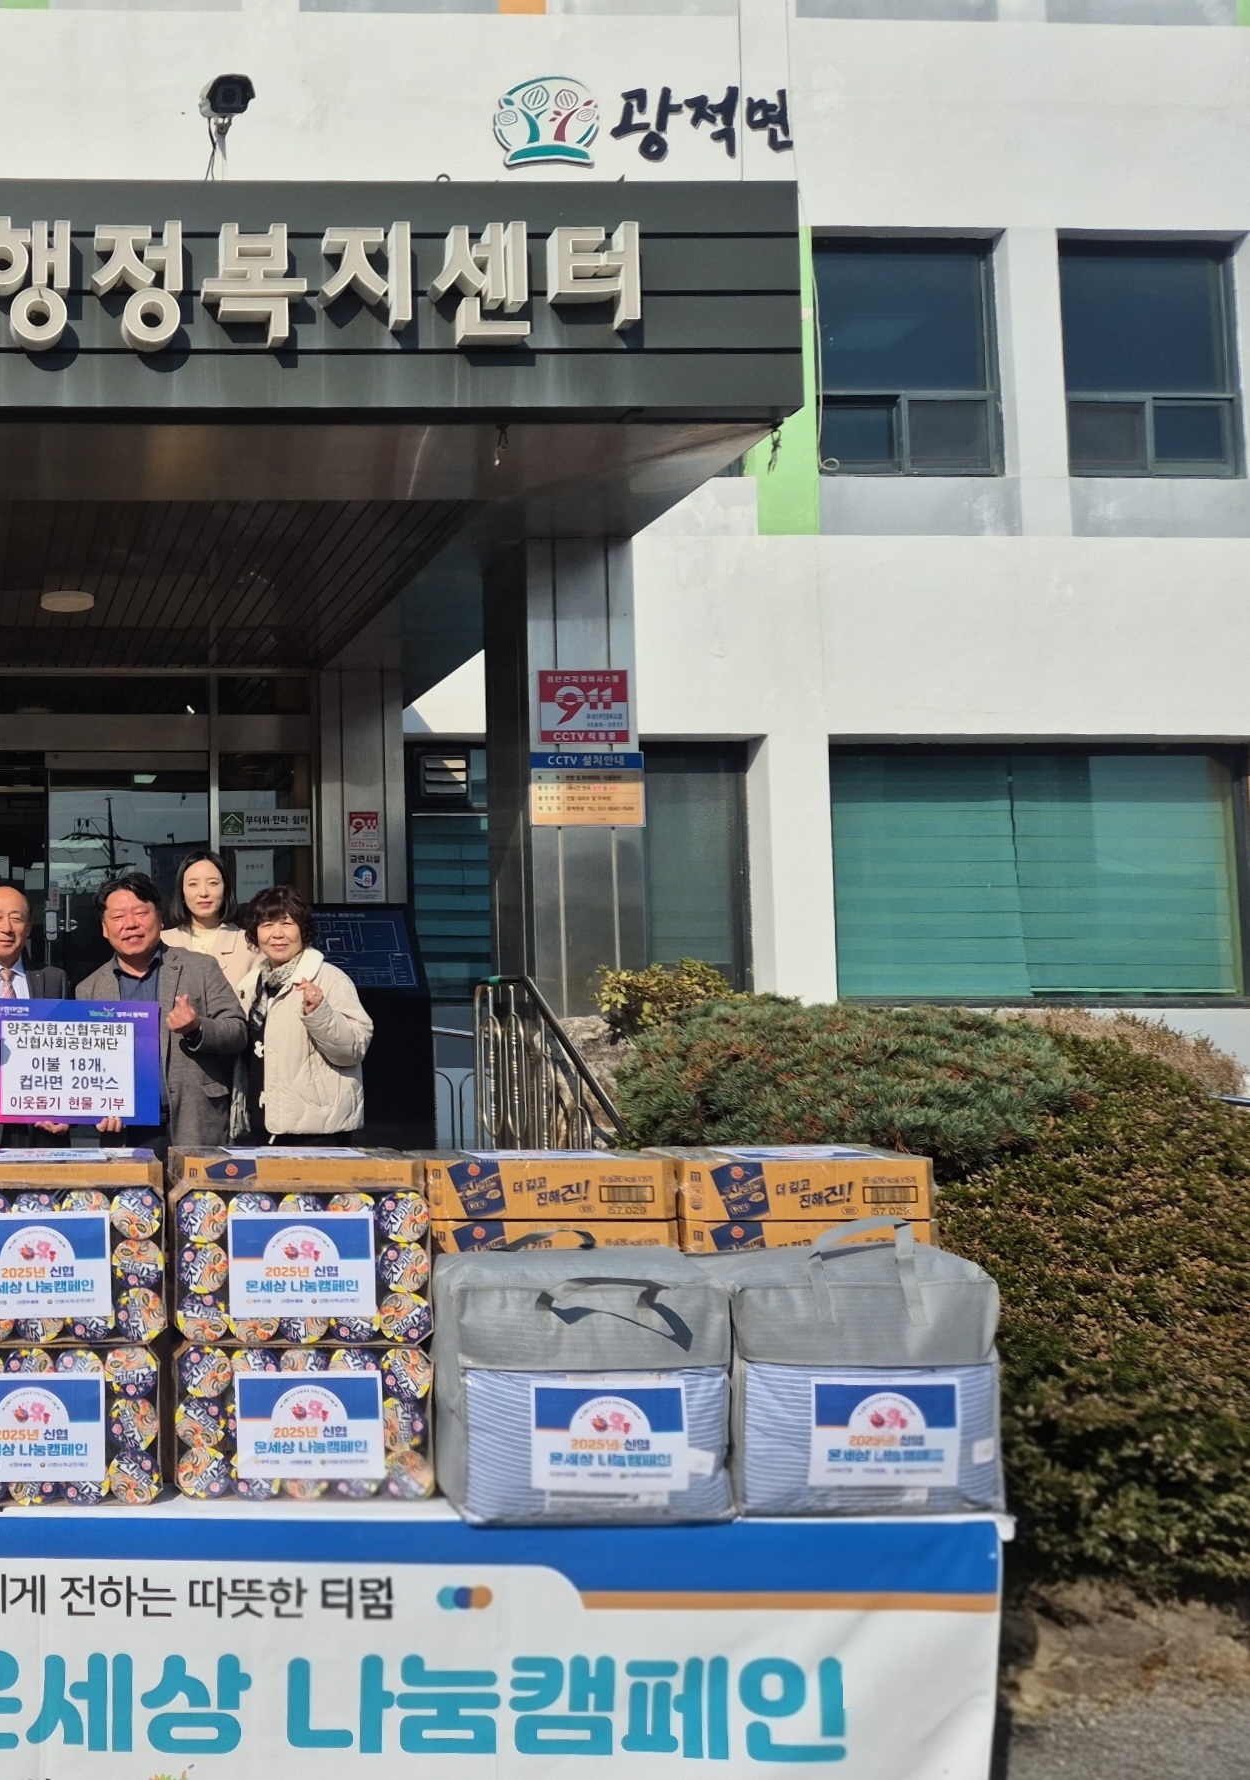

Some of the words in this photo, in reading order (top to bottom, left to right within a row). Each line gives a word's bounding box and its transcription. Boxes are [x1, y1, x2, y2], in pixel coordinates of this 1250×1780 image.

[611, 84, 793, 161] 광적면
[555, 685, 612, 725] 911
[553, 732, 585, 741] CCTV
[548, 755, 578, 765] CCTV
[582, 755, 625, 766] 설치안내
[351, 818, 377, 835] 911
[350, 854, 380, 863] 금연시설
[16, 1037, 118, 1050] 신협사회공헌재단
[32, 1057, 60, 1072] 이불
[69, 1058, 106, 1073] 18개,
[19, 1075, 63, 1091] 컵라면
[72, 1075, 119, 1091] 20박스
[10, 1096, 61, 1110] 이웃돕기
[68, 1096, 93, 1110] 현물
[101, 1096, 125, 1110] 기부
[1, 1266, 45, 1278] 2025년
[50, 1266, 74, 1278] 신협
[265, 1266, 309, 1277] 2025년
[314, 1266, 338, 1277] 신협
[26, 1279, 94, 1293] 나눔캠페인
[246, 1280, 286, 1293] 온세상
[291, 1280, 359, 1292] 나눔캠페인
[43, 1429, 68, 1441] 신협
[272, 1426, 317, 1438] 2025년
[322, 1426, 347, 1438] 신협
[20, 1443, 88, 1456] 나눔캠페인
[254, 1441, 295, 1454] 온세상
[299, 1440, 367, 1453] 나눔캠페인
[571, 1438, 620, 1450] 2025년
[60, 1574, 177, 1618] 전하는
[187, 1576, 308, 1619] 따뜻한
[287, 1653, 847, 1762] 나눔캠페인
